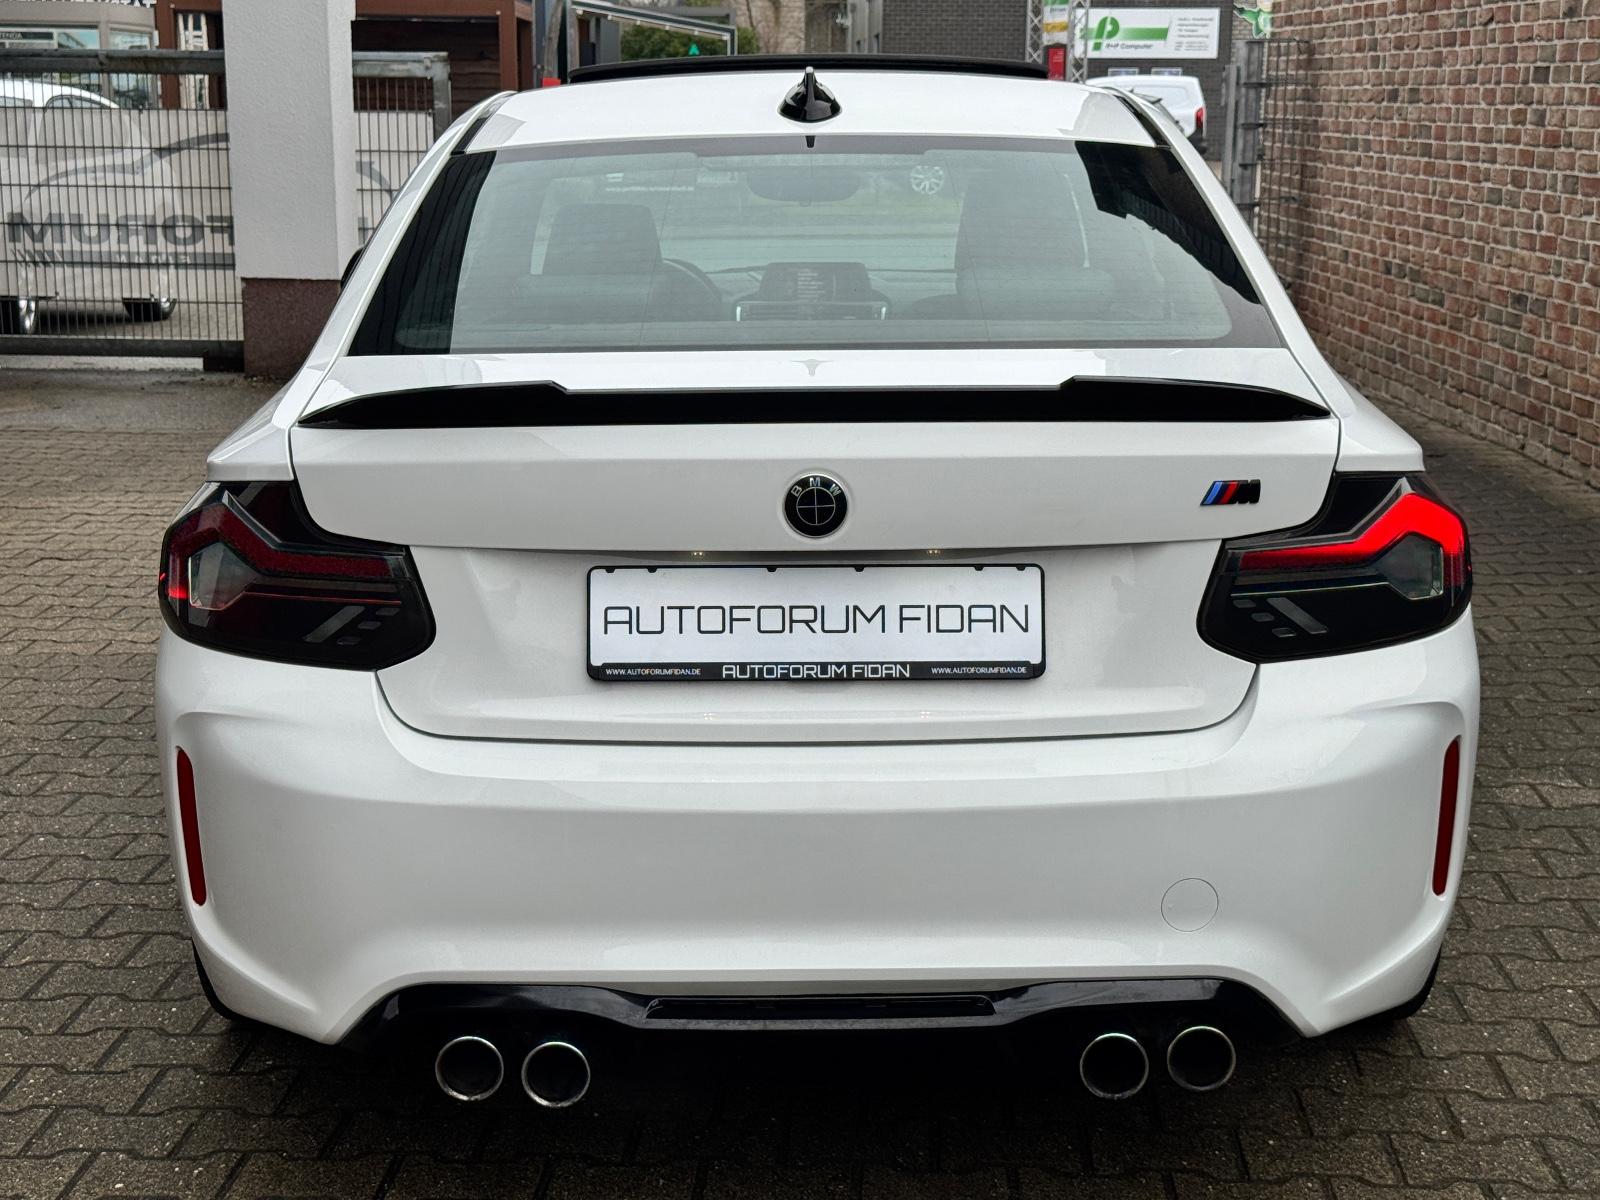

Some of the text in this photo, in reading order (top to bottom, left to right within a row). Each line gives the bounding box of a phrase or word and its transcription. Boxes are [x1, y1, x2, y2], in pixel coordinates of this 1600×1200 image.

[1120, 42, 1153, 50] Computer
[791, 477, 842, 497] BMW
[603, 604, 1029, 635] AUTOFORUM FIDAN
[605, 668, 701, 676] WWW.AUTOFORUMFIDAN.DE
[722, 664, 910, 679] AUTOFORUM FIDAN
[931, 666, 1027, 674] WWW.AUTOFORUMFIDAN.DE
